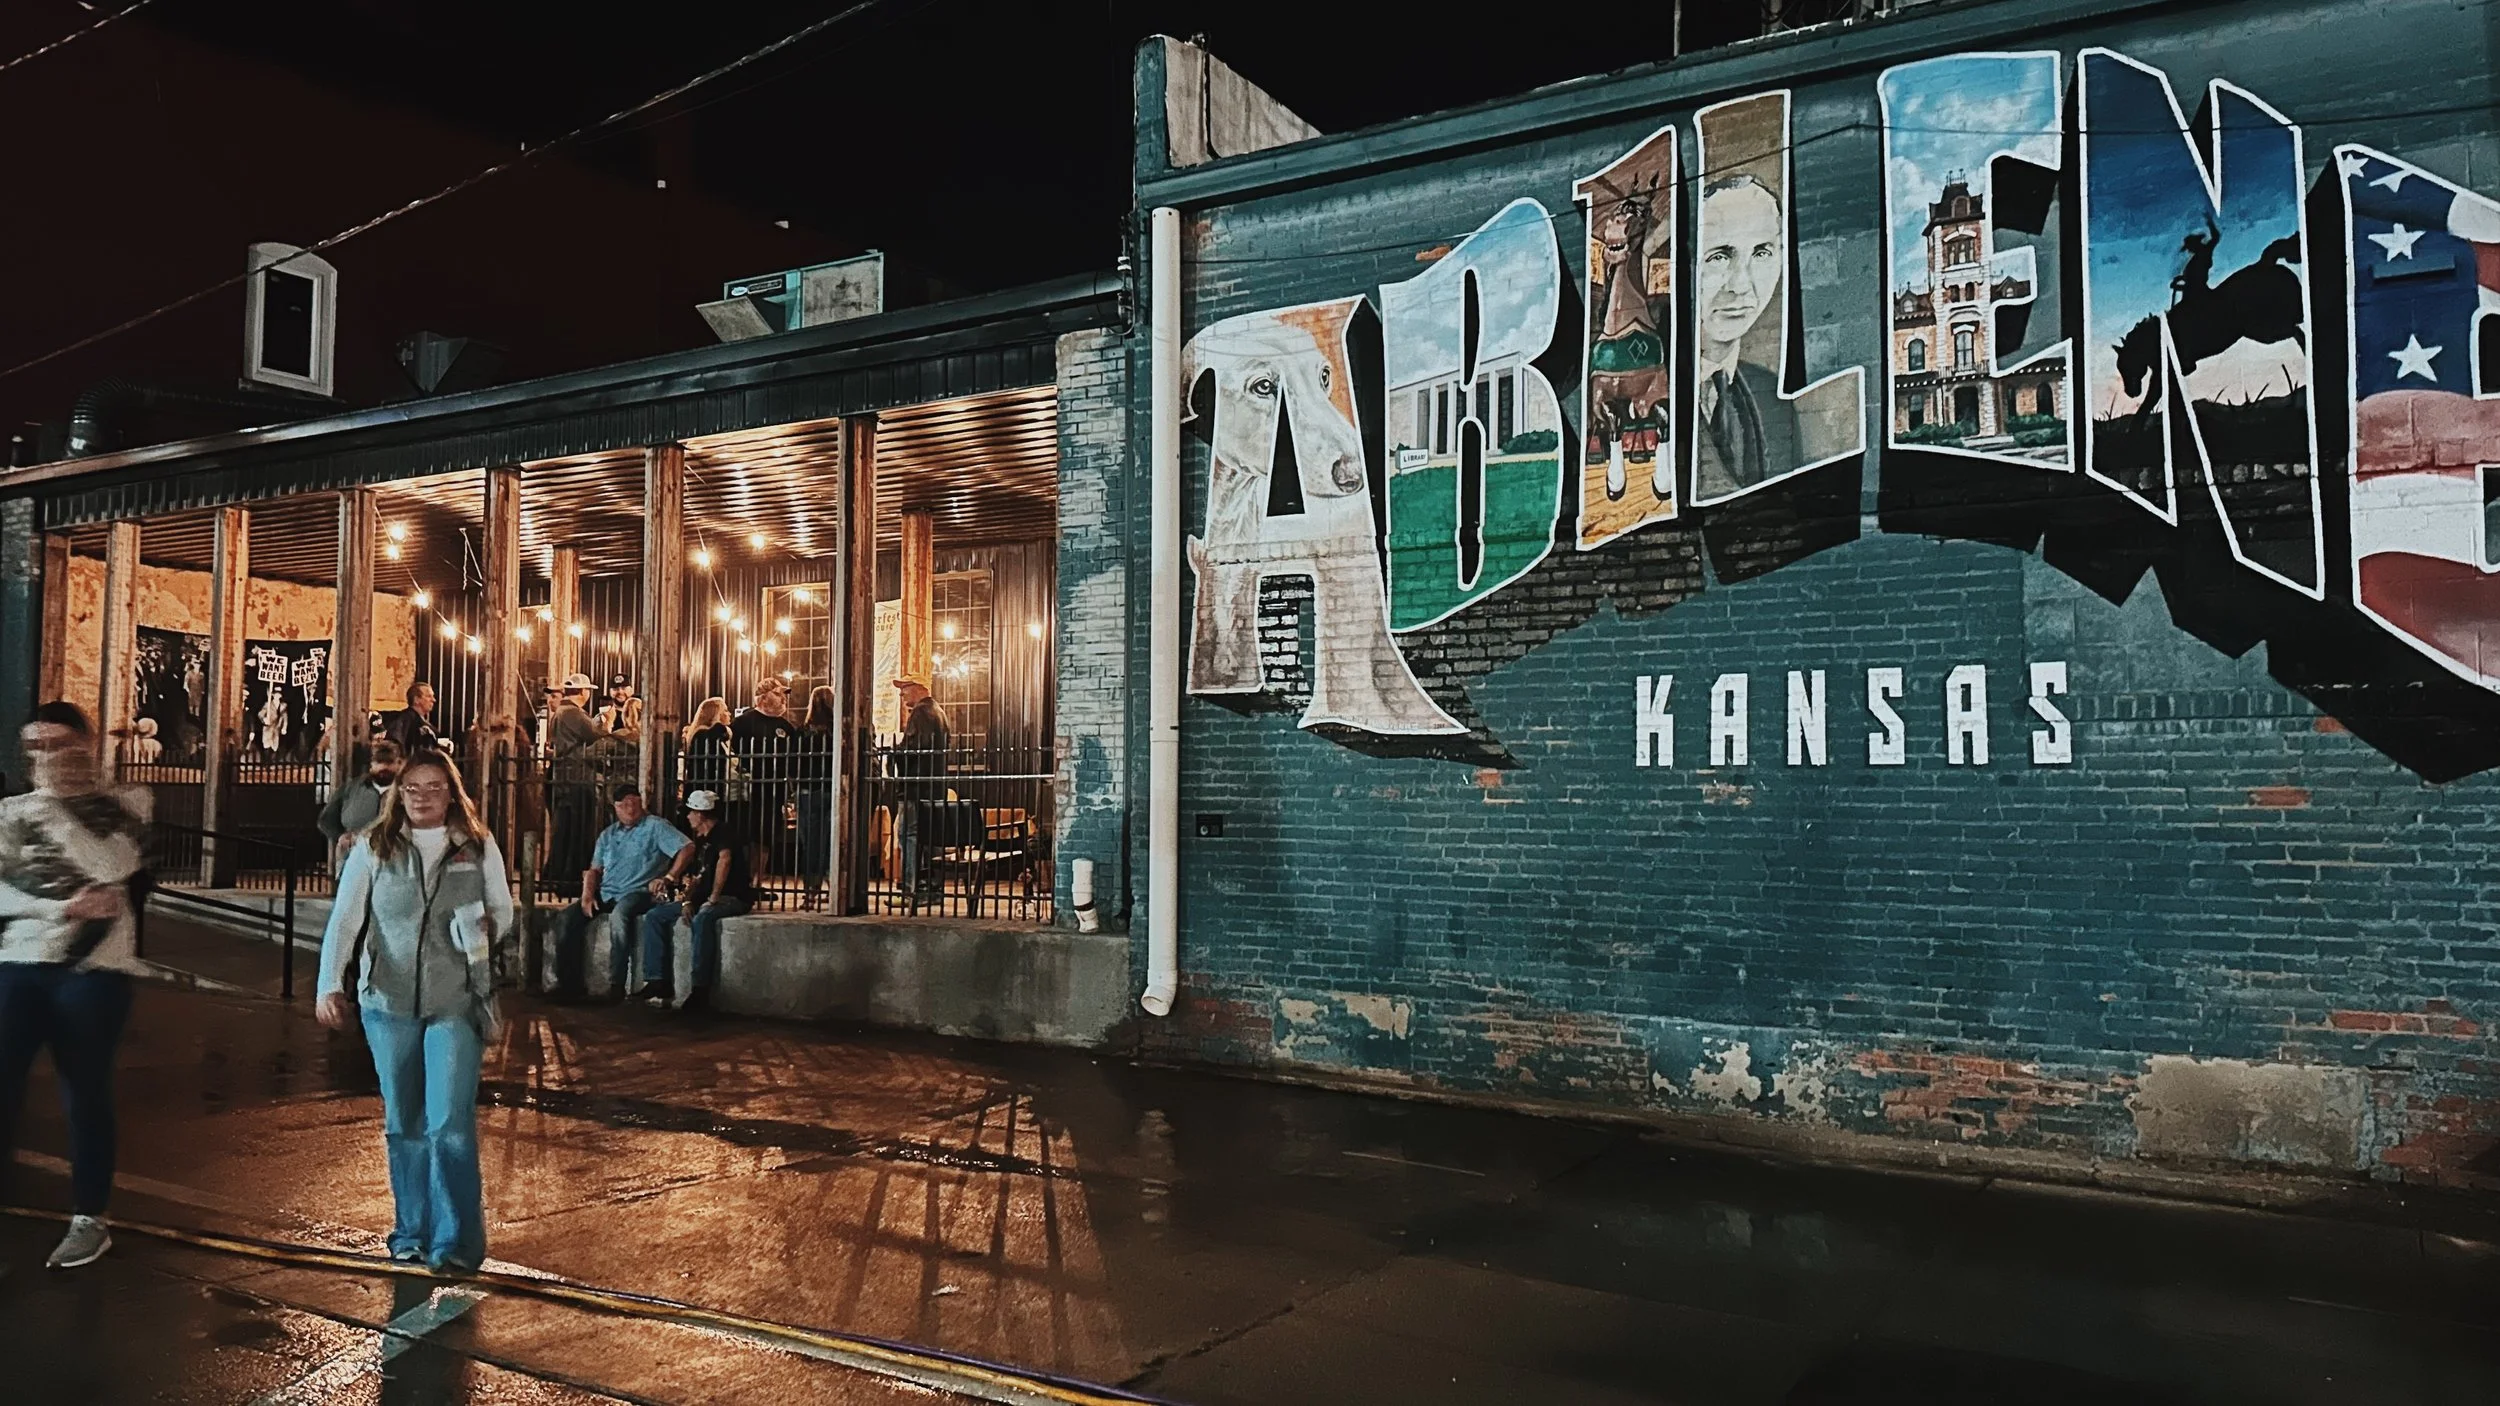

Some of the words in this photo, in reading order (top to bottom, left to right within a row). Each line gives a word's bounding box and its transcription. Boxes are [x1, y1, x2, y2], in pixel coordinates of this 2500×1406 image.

[266, 655, 284, 665] WE
[296, 660, 315, 669] WE
[262, 662, 285, 672] WANT
[294, 666, 315, 677] WANT
[260, 670, 284, 681] BEER
[1635, 661, 2073, 769] KANSAS
